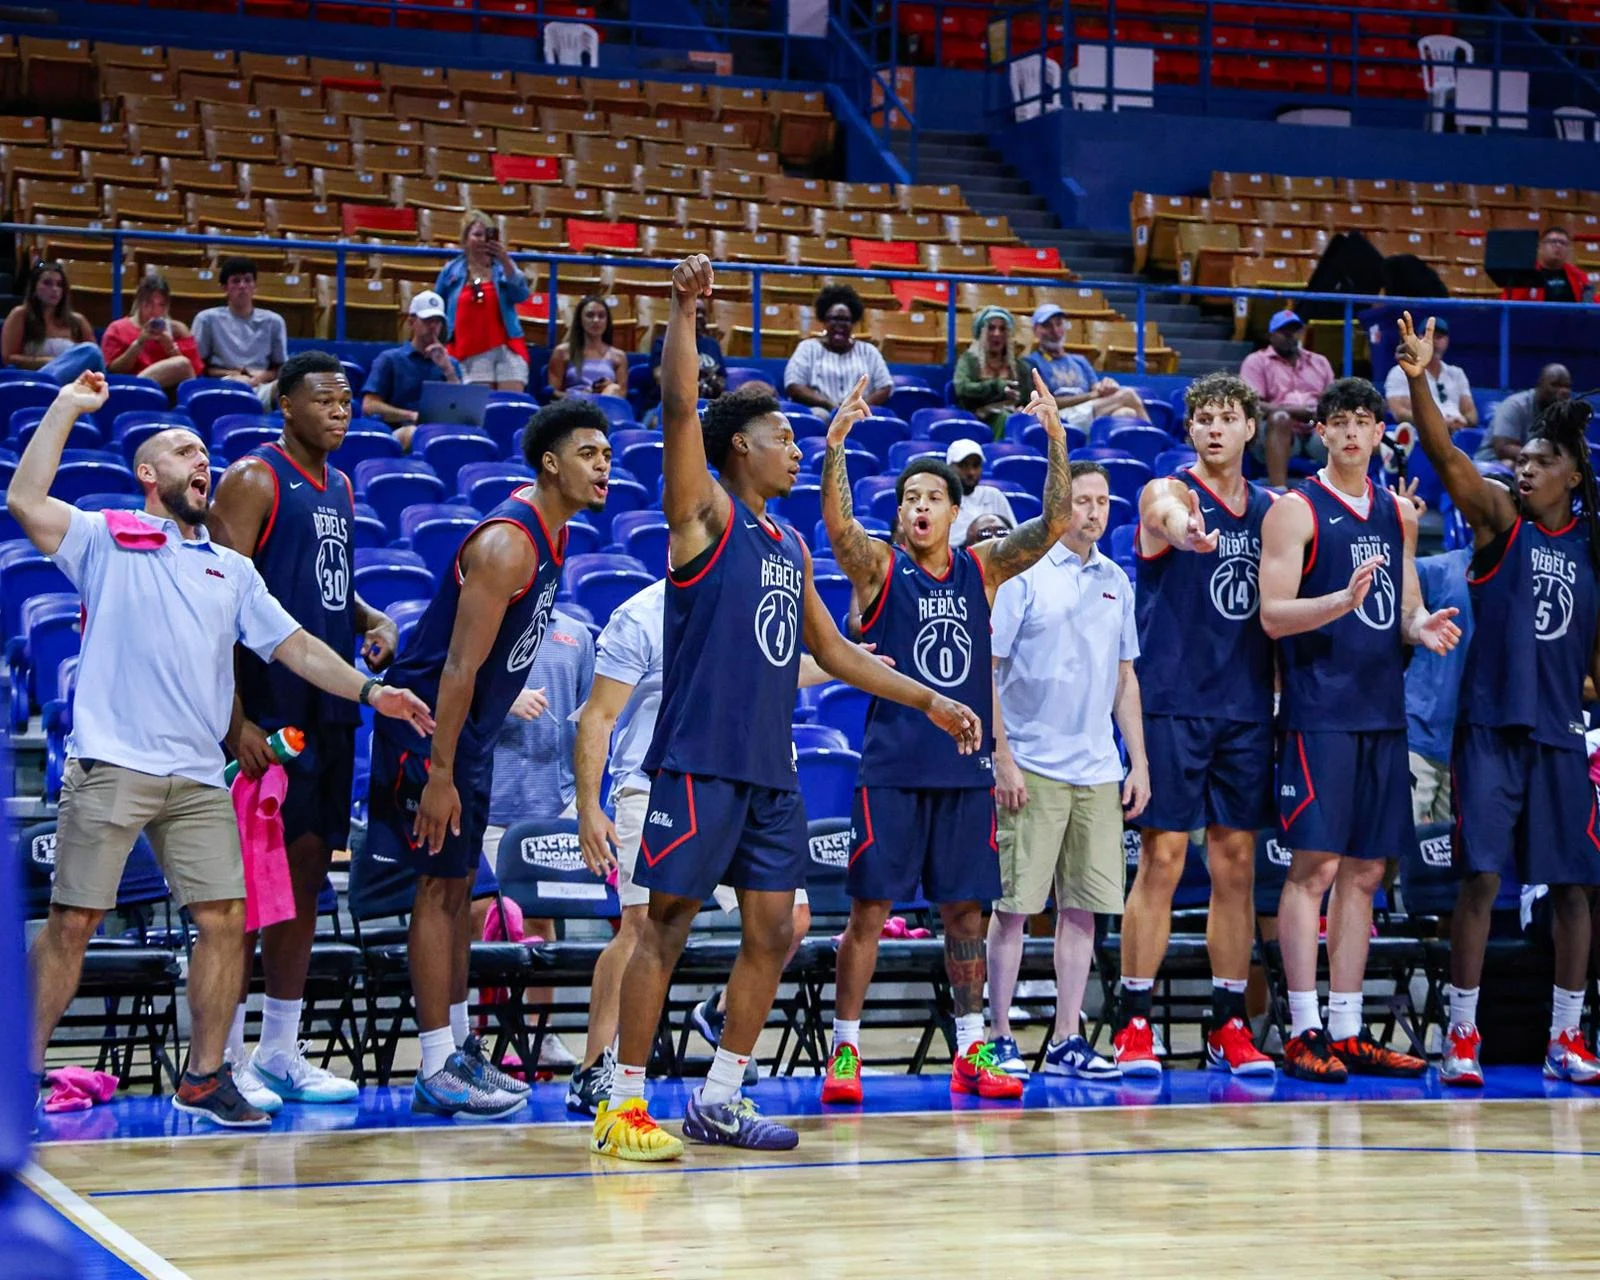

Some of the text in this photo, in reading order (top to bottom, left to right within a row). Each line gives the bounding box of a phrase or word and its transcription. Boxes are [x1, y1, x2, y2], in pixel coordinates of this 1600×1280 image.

[312, 512, 348, 544] REBELS
[761, 558, 802, 599] REBELS
[1531, 547, 1576, 585] REBELS
[323, 568, 345, 602] 30
[1228, 580, 1249, 610] 14
[1374, 591, 1386, 622] 1
[1534, 600, 1552, 631] 5
[776, 621, 786, 657] 4
[939, 647, 953, 679] 0
